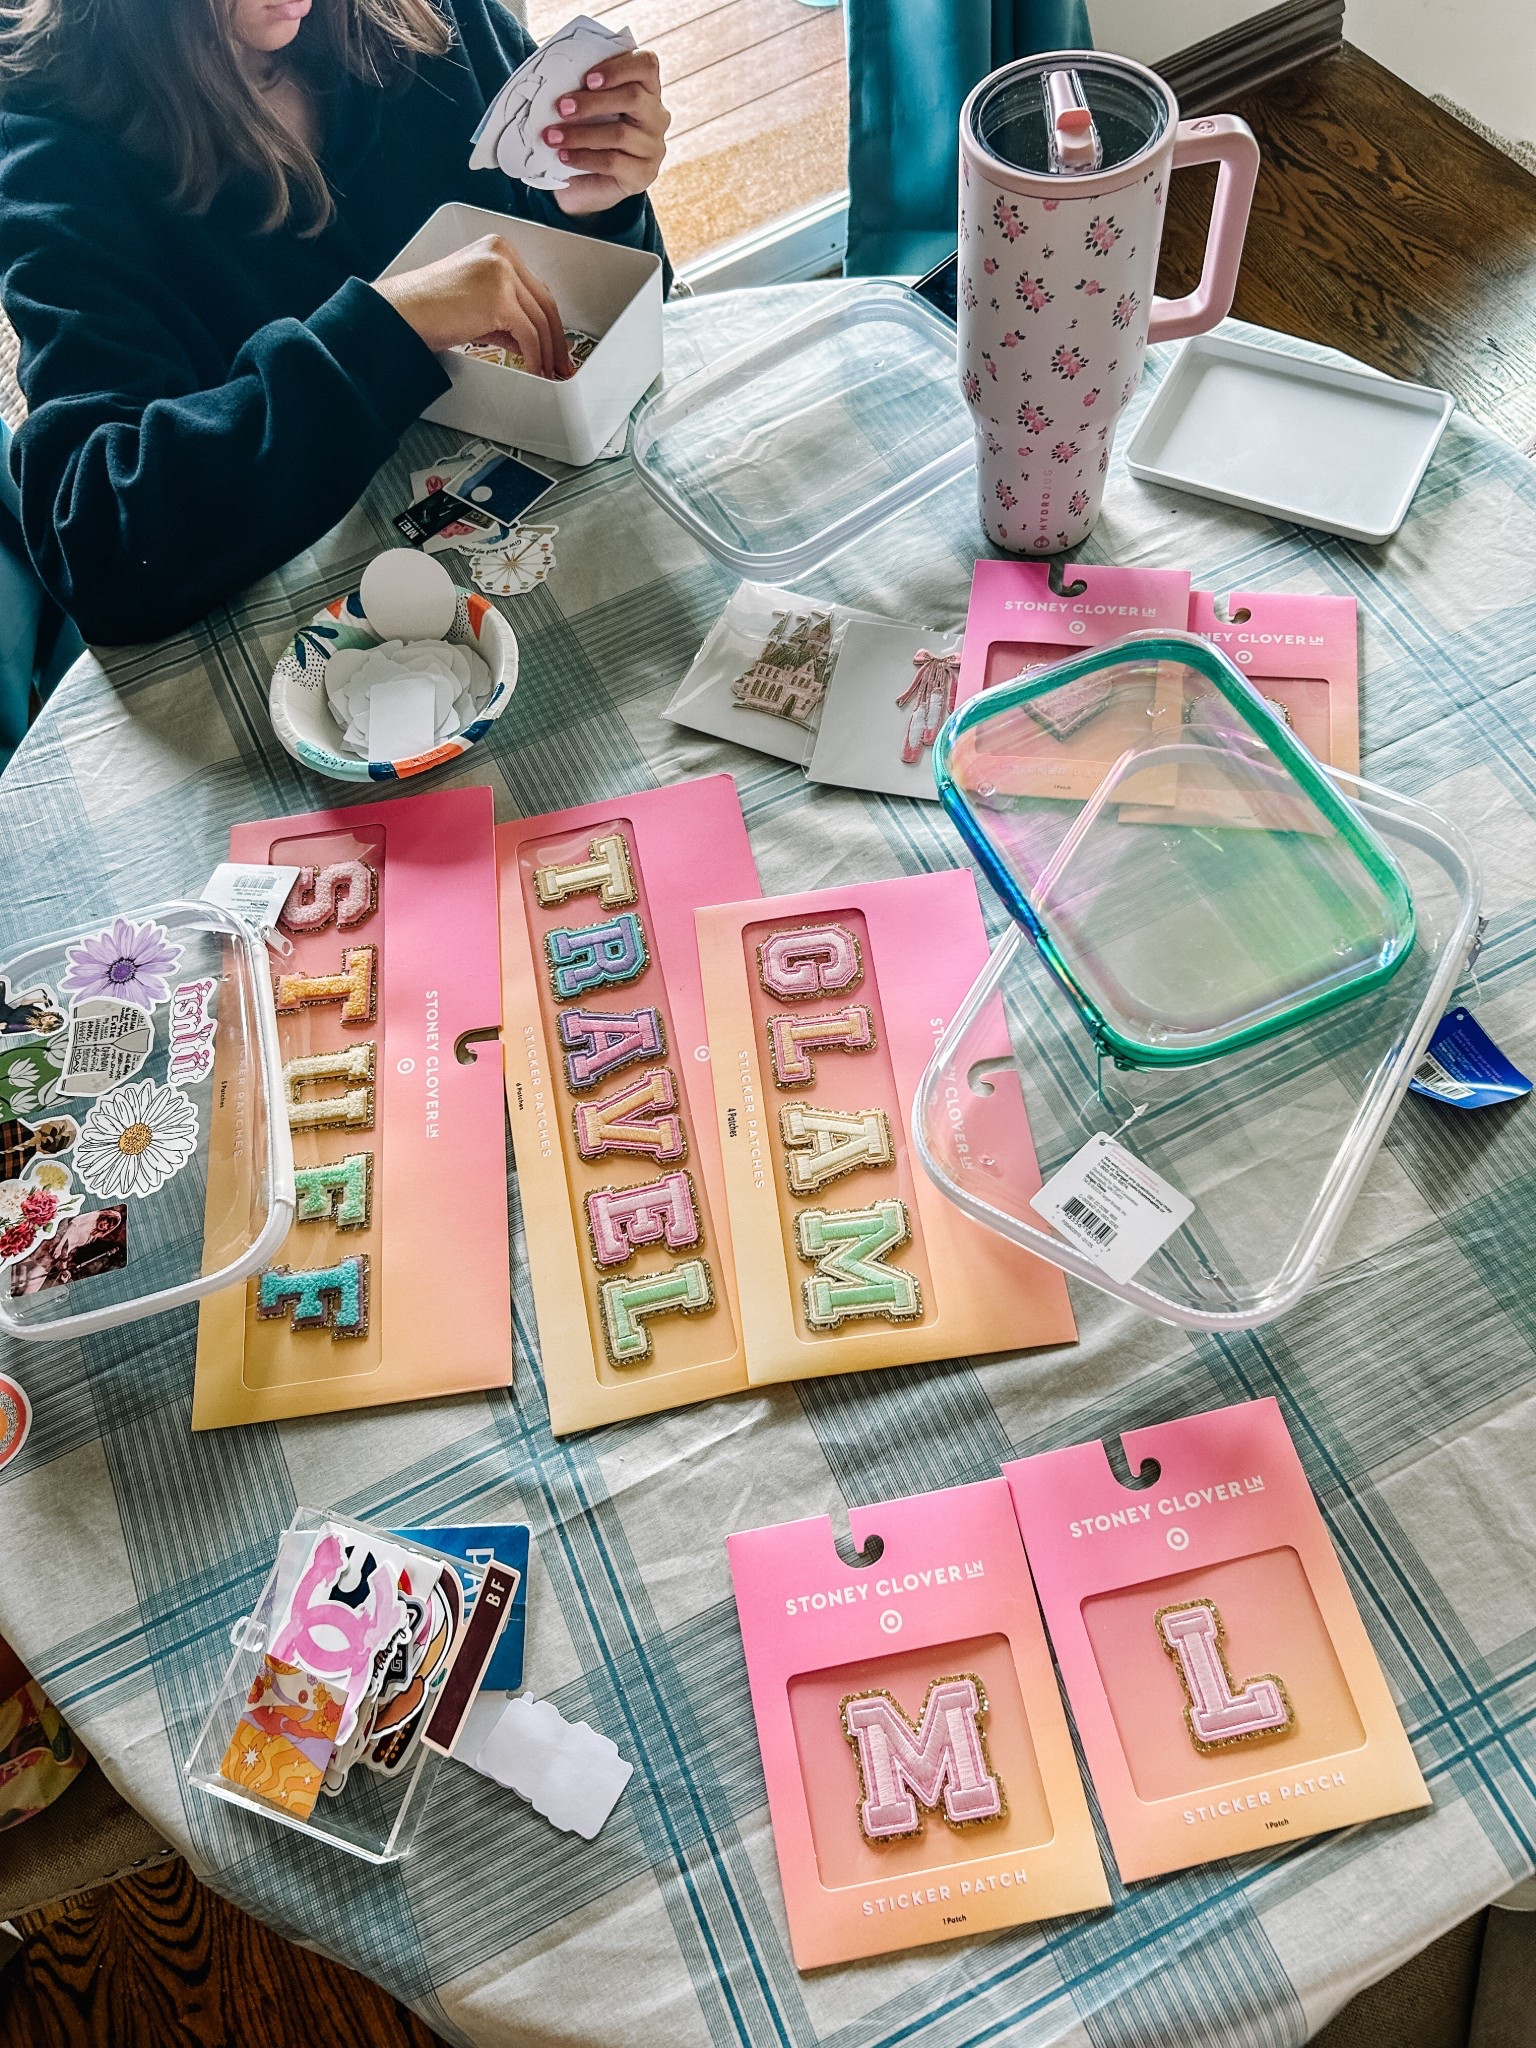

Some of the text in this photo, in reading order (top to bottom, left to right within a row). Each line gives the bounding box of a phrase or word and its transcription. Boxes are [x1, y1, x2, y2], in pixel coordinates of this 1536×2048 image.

[397, 517, 419, 540] ME!
[509, 540, 521, 548] Give
[1004, 600, 1155, 617] STONEY CLOVER LN
[1236, 632, 1305, 645] CLOVER
[1308, 635, 1323, 645] LN
[424, 990, 440, 1138] STONEY CLOVER LN
[522, 1025, 552, 1159] STICKER PATCHES
[218, 1085, 227, 1108] Patches
[232, 1091, 247, 1157] PATCHES
[515, 1086, 525, 1110] Patches
[532, 832, 715, 1371] TRAVEL
[725, 1112, 740, 1138] Patches
[737, 1050, 765, 1189] STICKER PATCHES
[755, 921, 923, 1332] GLAM
[944, 1086, 971, 1155] CLOVER
[1067, 1474, 1264, 1539] STONEY CLOVER LN
[783, 1559, 984, 1616] STONEY CLOVER LN
[1157, 1601, 1292, 1748] L
[842, 1676, 1004, 1842] M
[1181, 1769, 1347, 1825] STICKER PATCH
[860, 1868, 1028, 1916] STICKER PATCH
